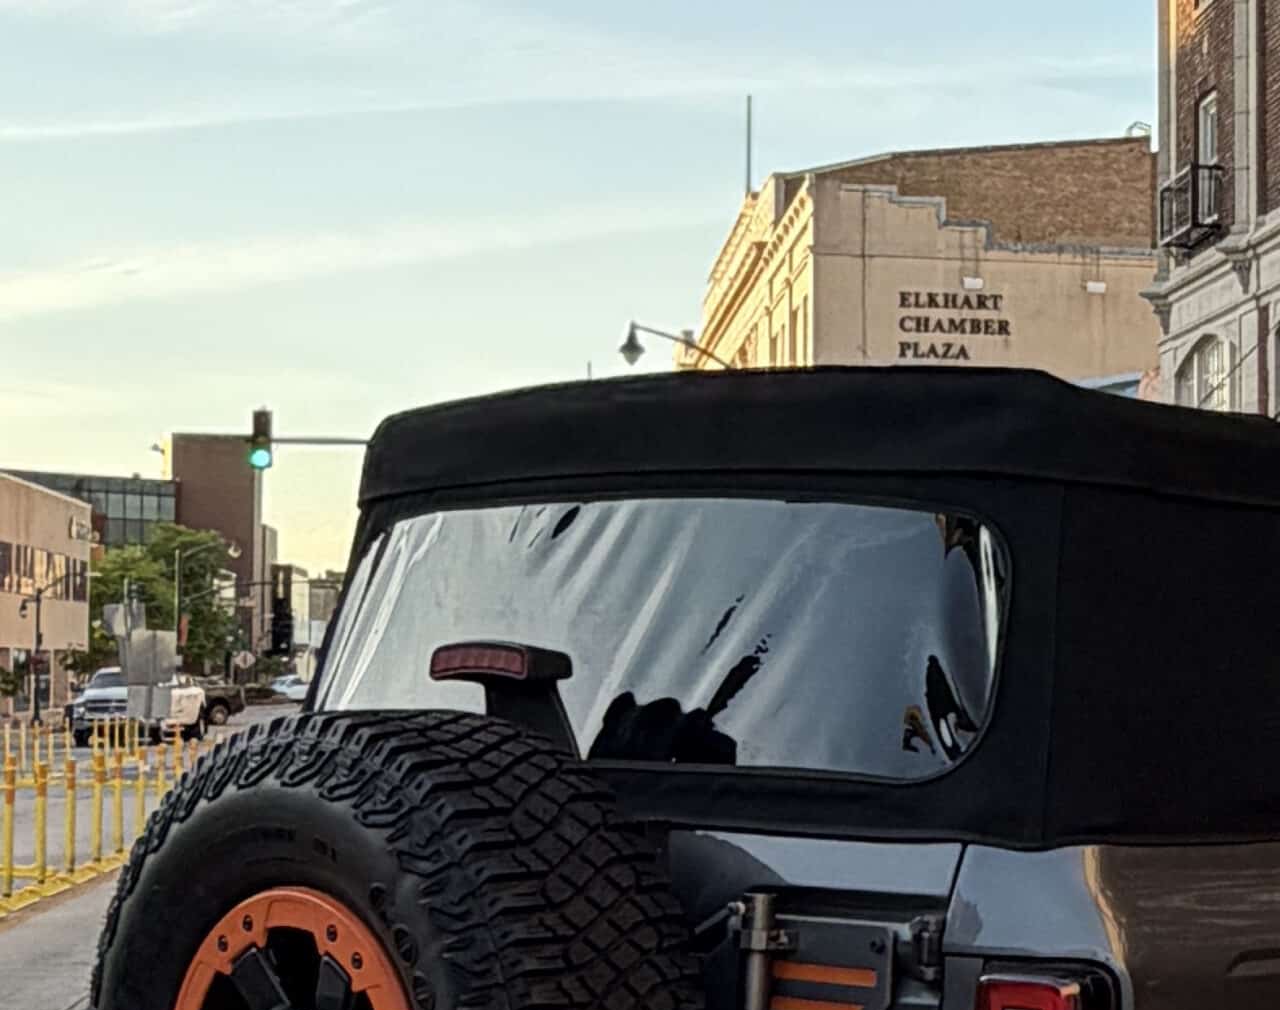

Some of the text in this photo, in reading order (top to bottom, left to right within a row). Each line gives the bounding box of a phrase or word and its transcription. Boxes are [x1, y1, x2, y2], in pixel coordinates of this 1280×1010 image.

[898, 291, 1003, 311] ELKHART
[898, 316, 1011, 336] CHAMBER
[898, 342, 970, 360] PLAZA
